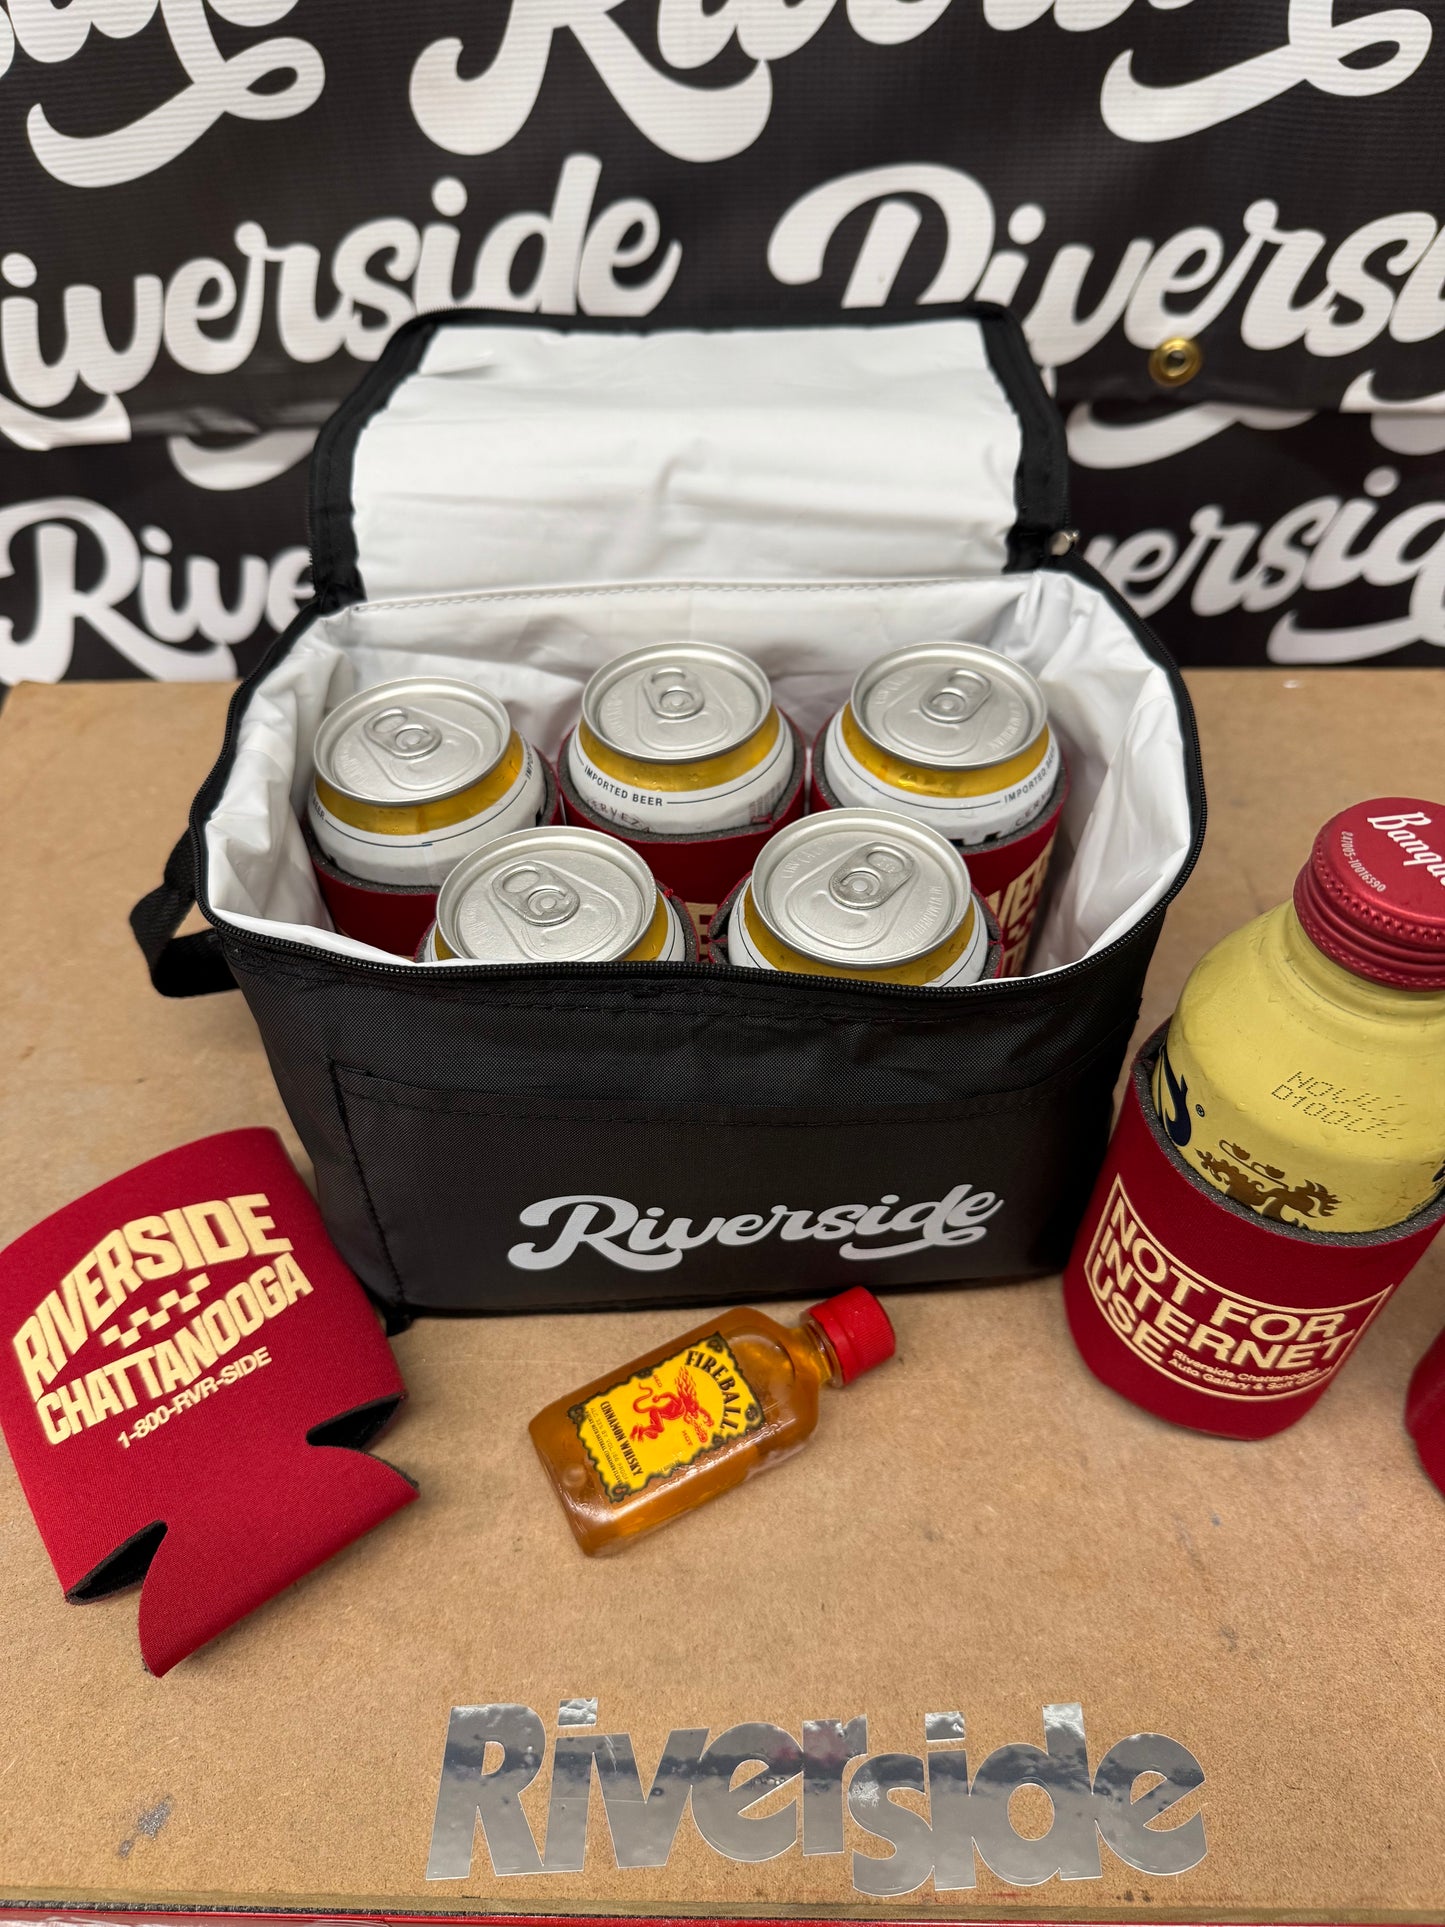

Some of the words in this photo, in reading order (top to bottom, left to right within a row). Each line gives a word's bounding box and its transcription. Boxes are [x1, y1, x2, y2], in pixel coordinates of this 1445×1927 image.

[0, 153, 682, 450] iverside
[584, 765, 628, 799] IMPORTED
[632, 793, 663, 807] BEER
[1004, 768, 1047, 803] IMPORTED
[1366, 811, 1445, 888] Banqu
[508, 1183, 1004, 1271] Riverside
[1110, 1196, 1206, 1305] NOT
[1210, 1297, 1346, 1341] FOR
[12, 1193, 294, 1402] RIVERSIDE
[1091, 1252, 1171, 1363] USE
[1100, 1225, 1356, 1370] INTERNET
[36, 1251, 314, 1445] CHATTANOOGA
[684, 1350, 742, 1431] FIREBALL
[1167, 1358, 1200, 1377] Auto
[1202, 1371, 1250, 1391] Gallery
[1252, 1382, 1264, 1391] &
[1172, 1349, 1235, 1379] Riverside
[116, 1346, 272, 1449] 1-800-RVR-SIDE
[600, 1401, 626, 1442] CINNAMON
[619, 1440, 644, 1477] WHISKY
[426, 1697, 1209, 1898] Riverside
